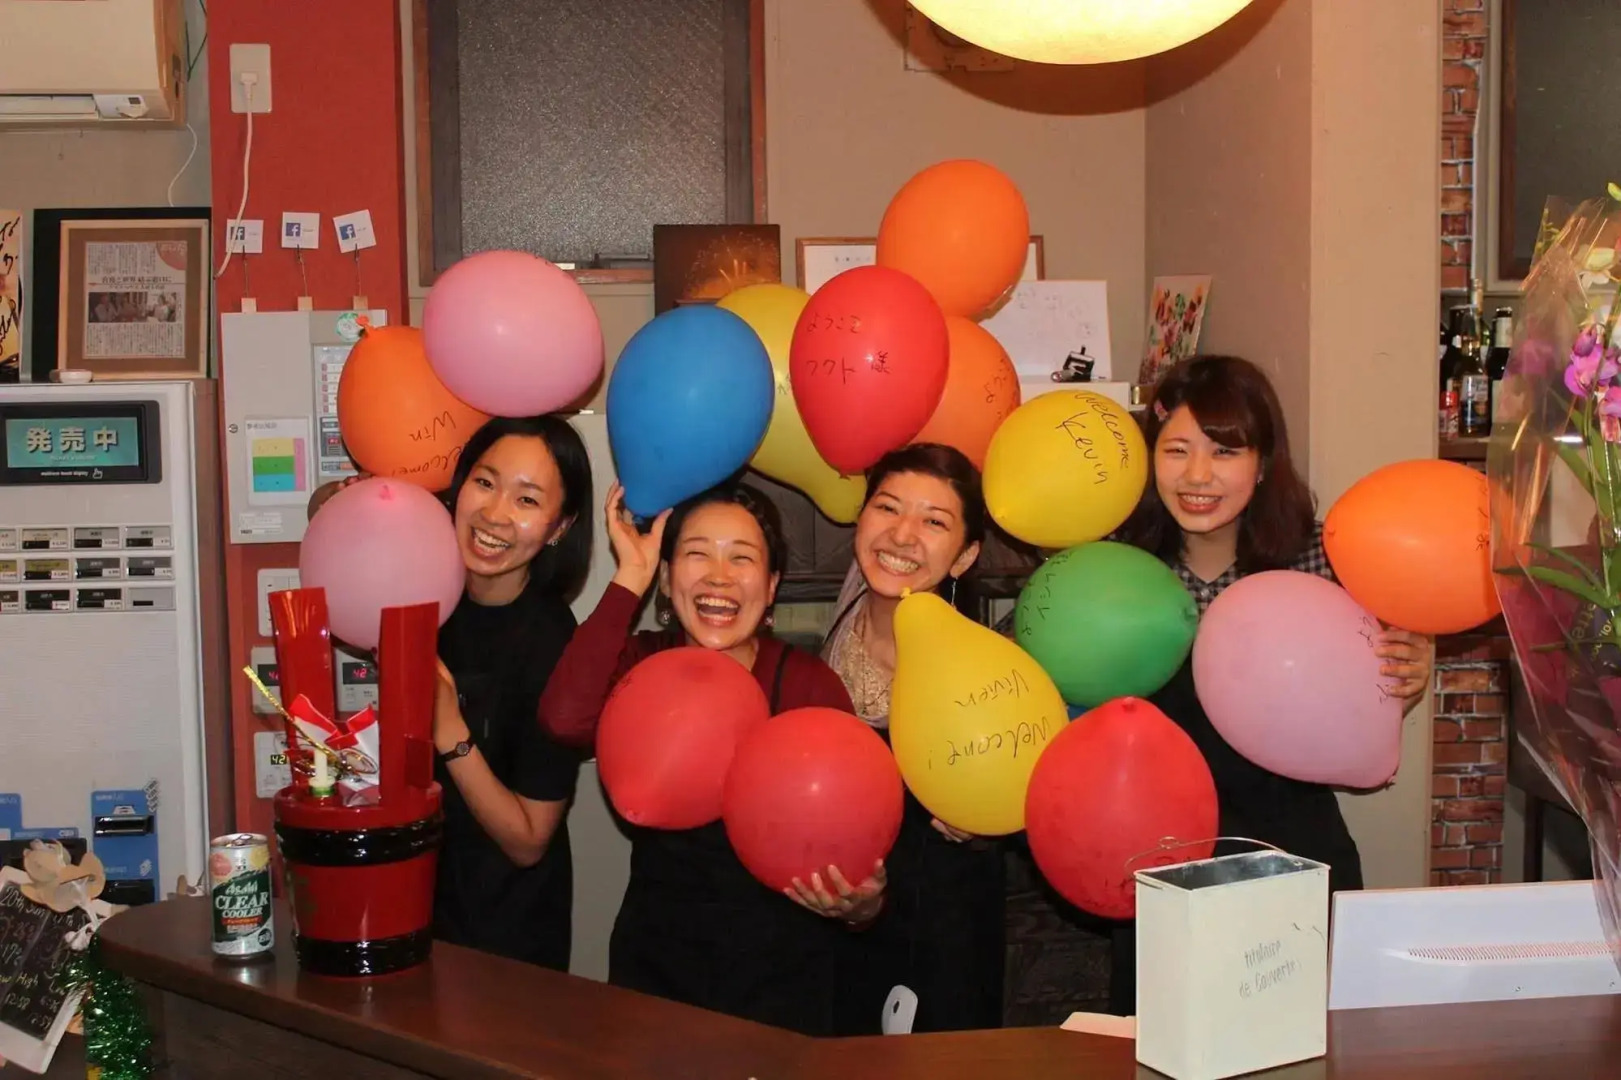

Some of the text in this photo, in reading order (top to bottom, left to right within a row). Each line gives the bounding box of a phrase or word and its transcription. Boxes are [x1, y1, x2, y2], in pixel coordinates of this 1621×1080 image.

[807, 312, 861, 334] ようこそ
[408, 410, 457, 441] Win
[26, 425, 119, 453] 発売中
[1055, 411, 1109, 485] Kevin
[391, 446, 463, 477] elcome!
[271, 755, 286, 765] 42
[225, 880, 258, 895] Asahi
[215, 891, 269, 910] CLEAR
[222, 907, 263, 919] COOLER
